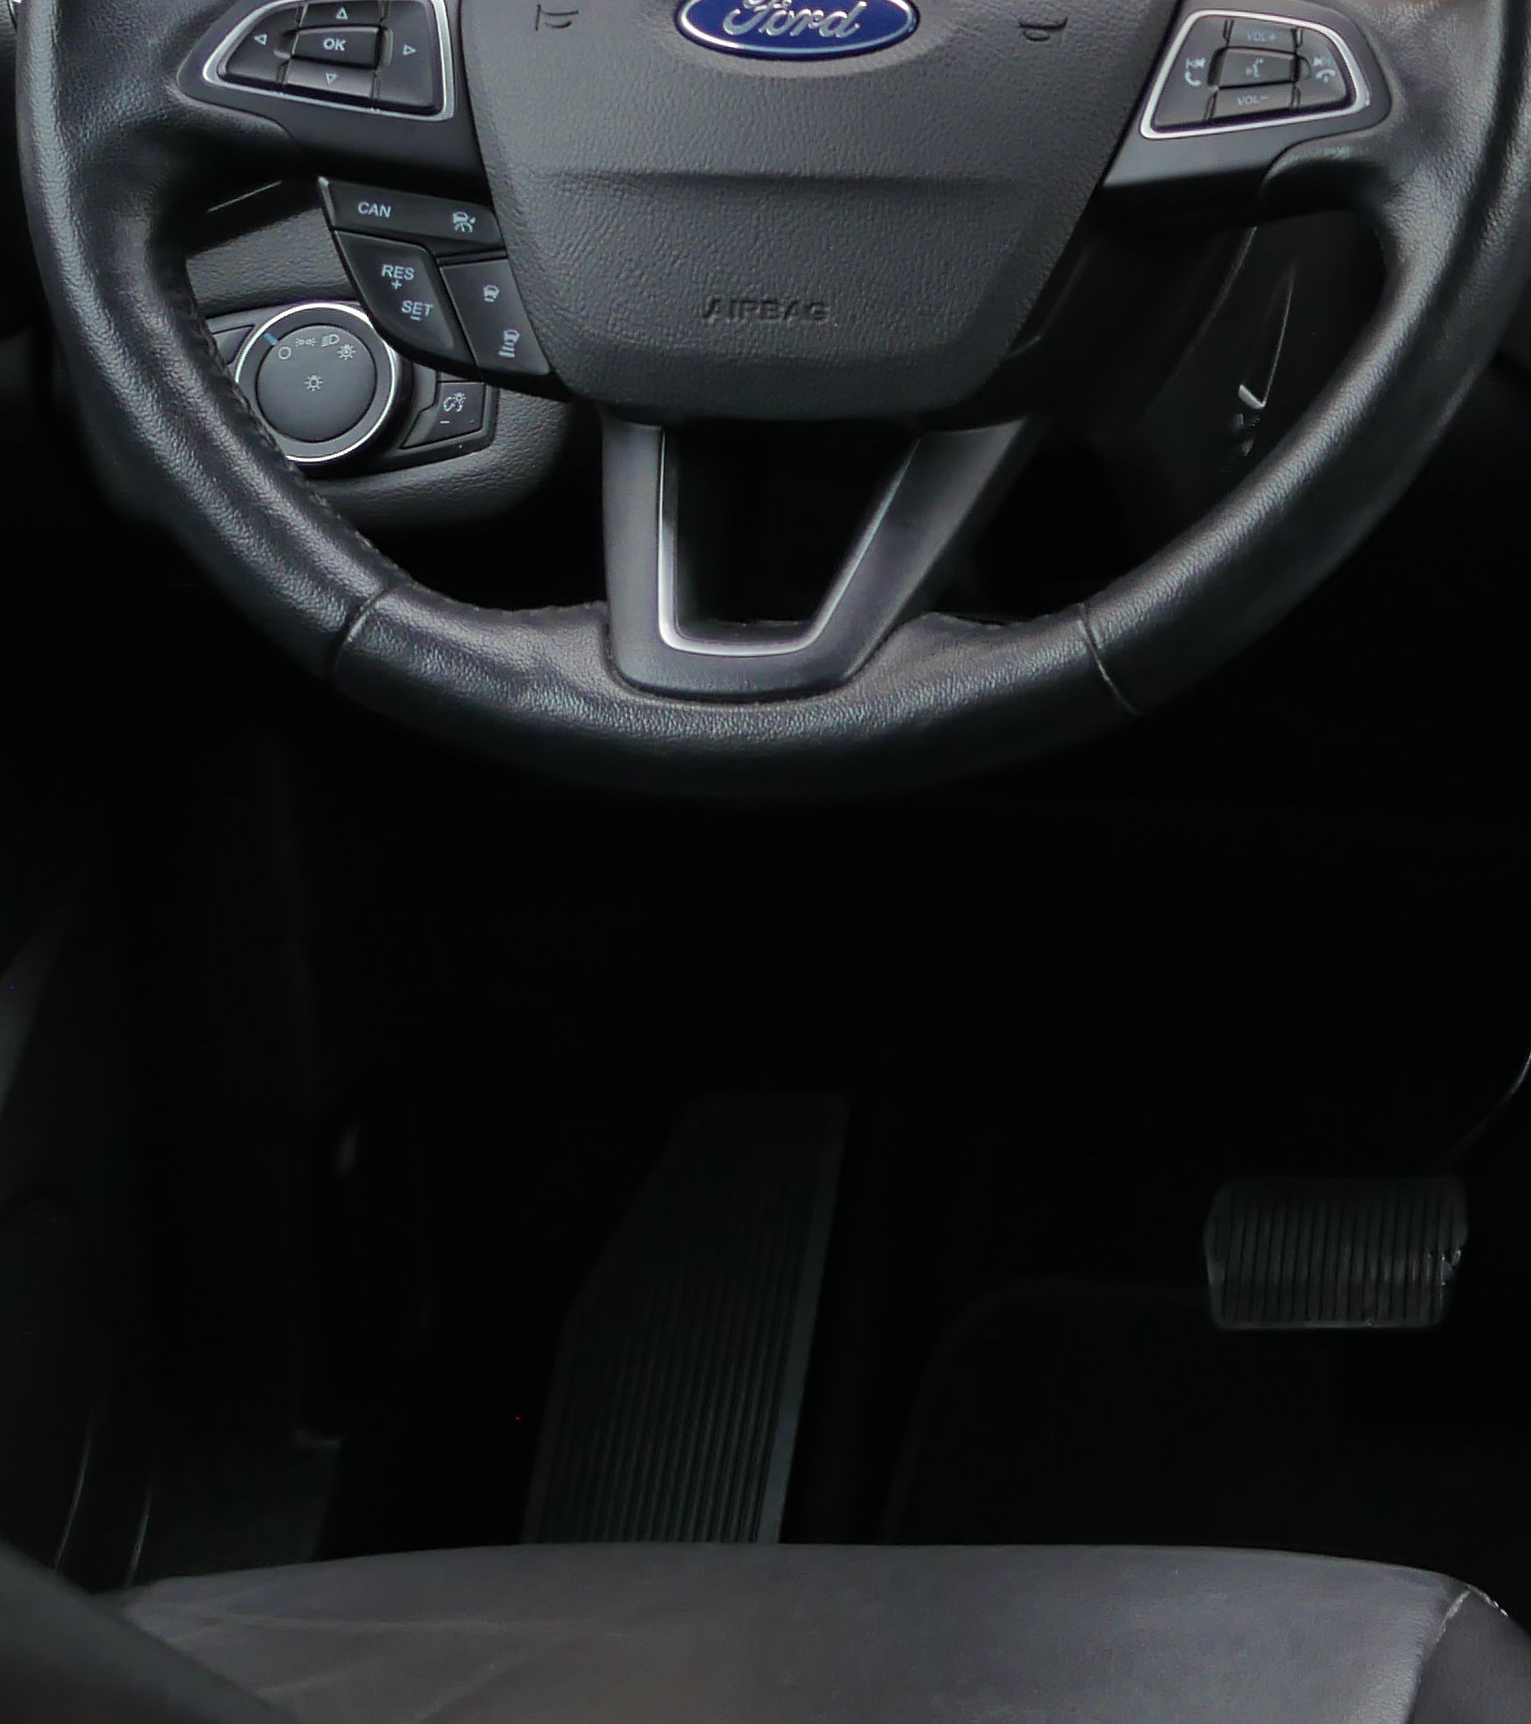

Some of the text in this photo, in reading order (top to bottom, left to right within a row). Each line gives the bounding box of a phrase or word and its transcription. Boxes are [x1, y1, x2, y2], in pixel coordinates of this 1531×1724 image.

[322, 37, 347, 52] OK
[357, 201, 391, 219] CAN
[380, 262, 415, 282] RES
[401, 299, 433, 317] SET
